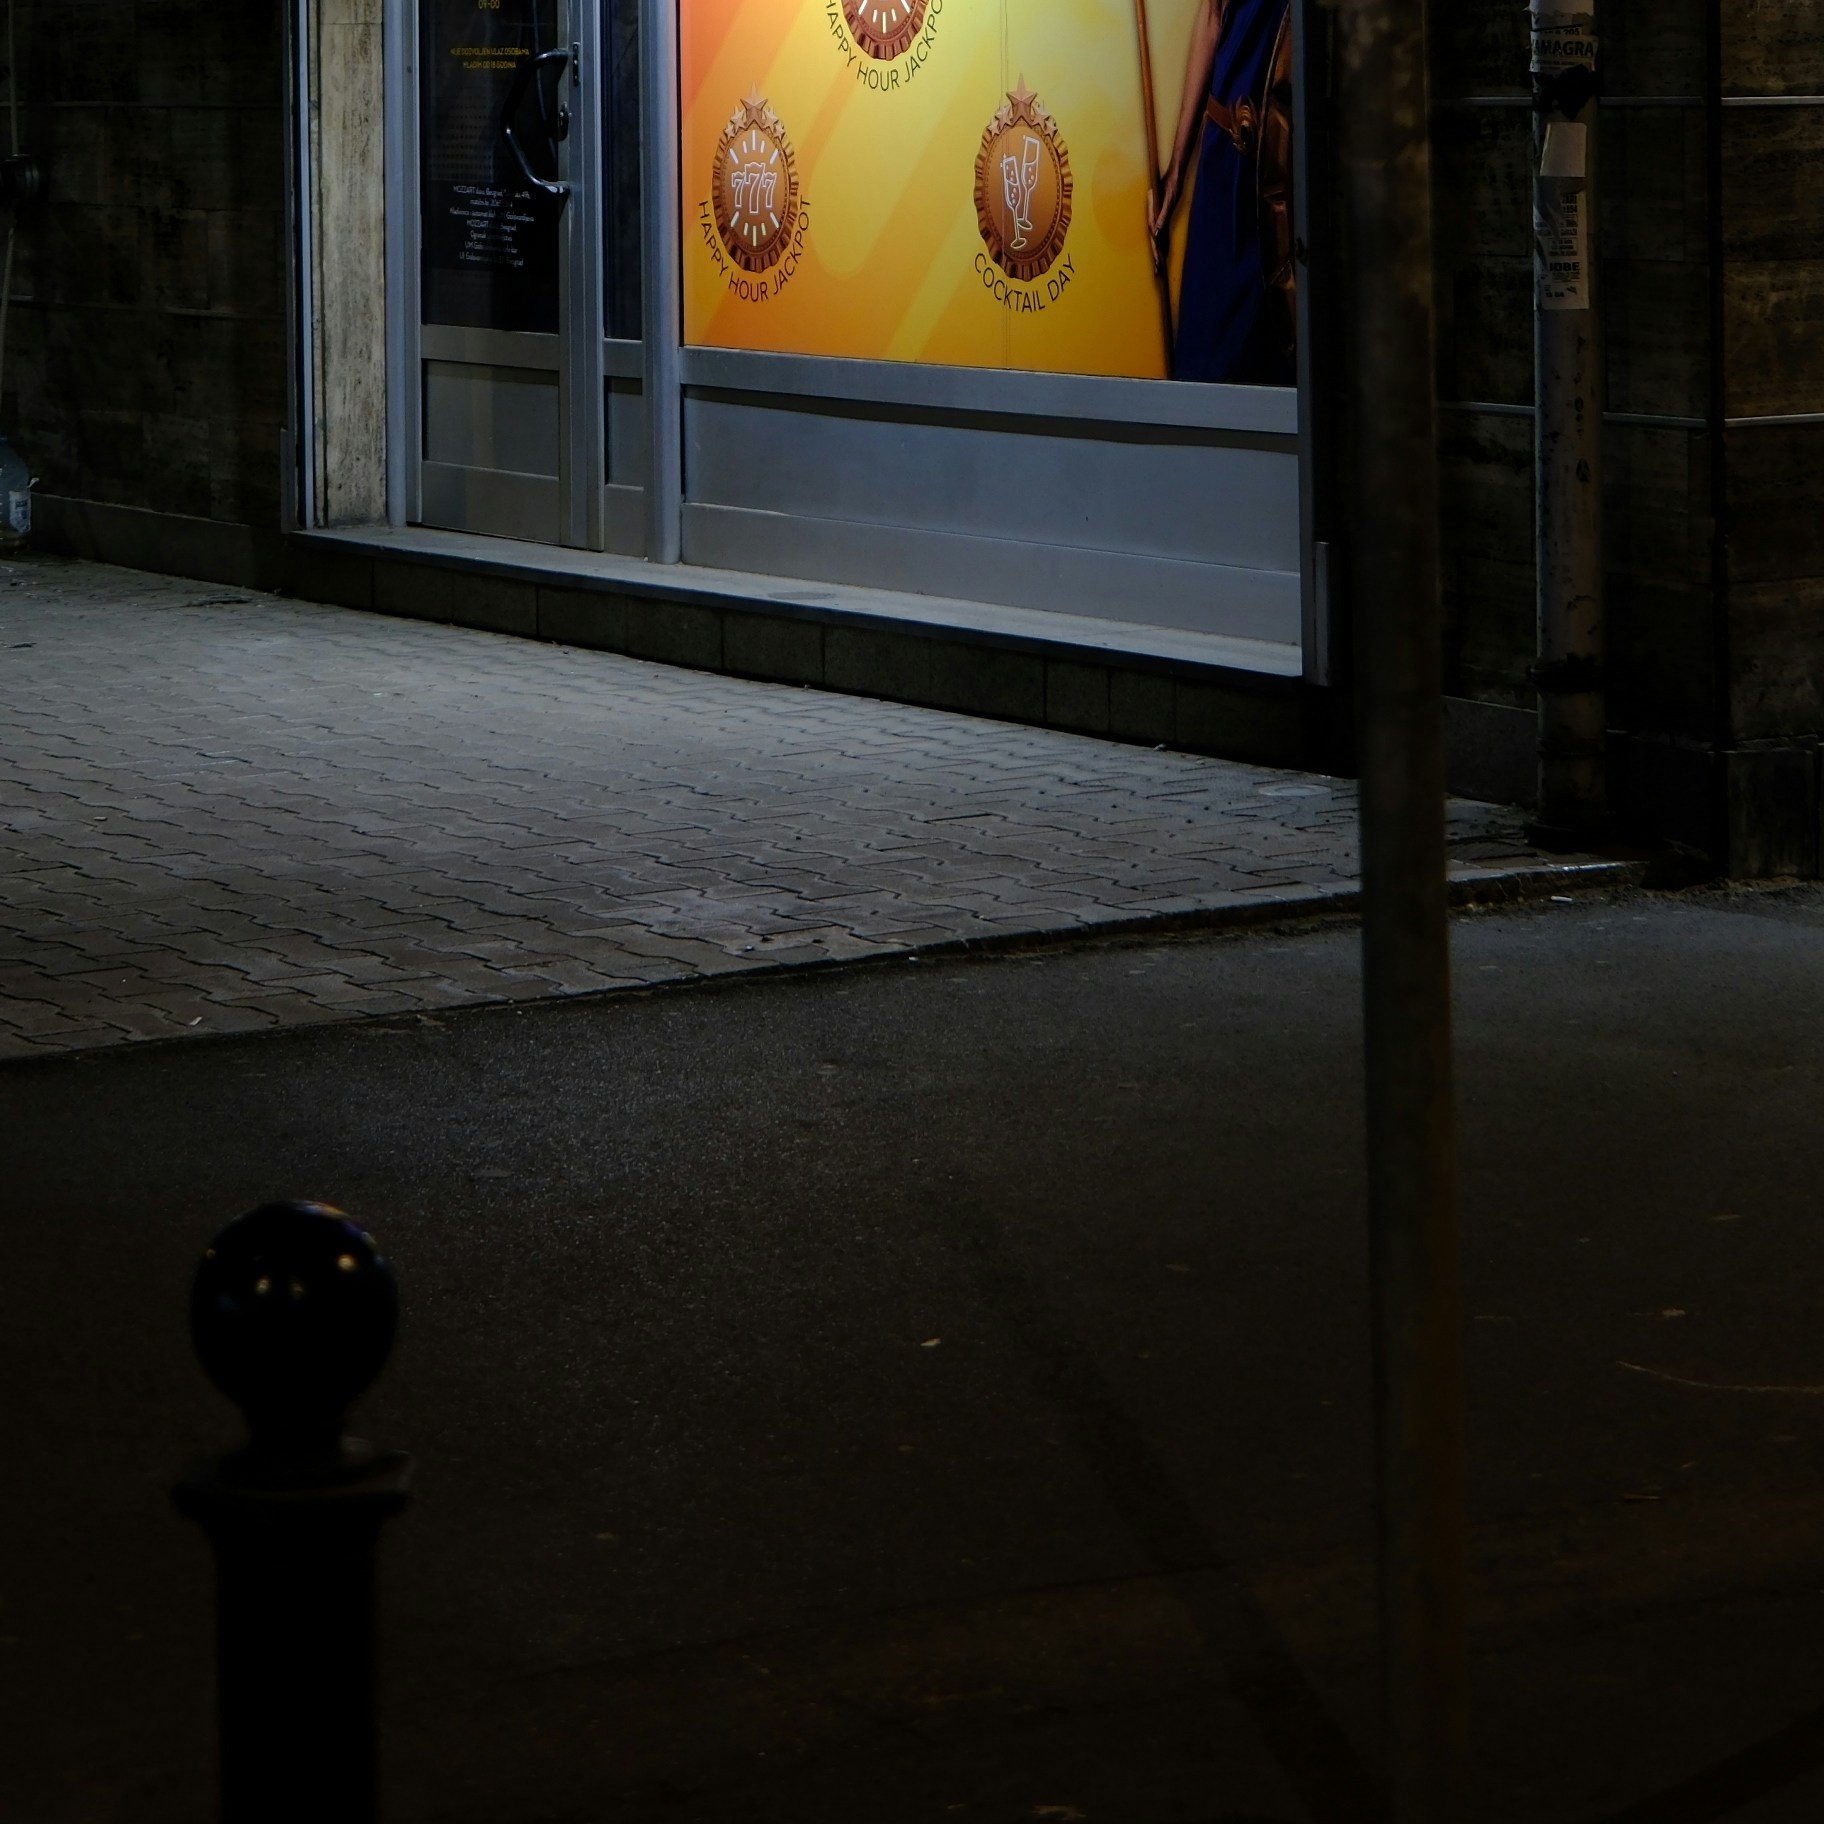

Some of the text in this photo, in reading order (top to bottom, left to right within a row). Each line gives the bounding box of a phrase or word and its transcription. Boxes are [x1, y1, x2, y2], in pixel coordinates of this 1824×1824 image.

[856, 61, 899, 92] HOUR
[698, 199, 810, 303] HAPPY HOUR JACKPOT
[974, 253, 1076, 313] COCKTAIL DAY
